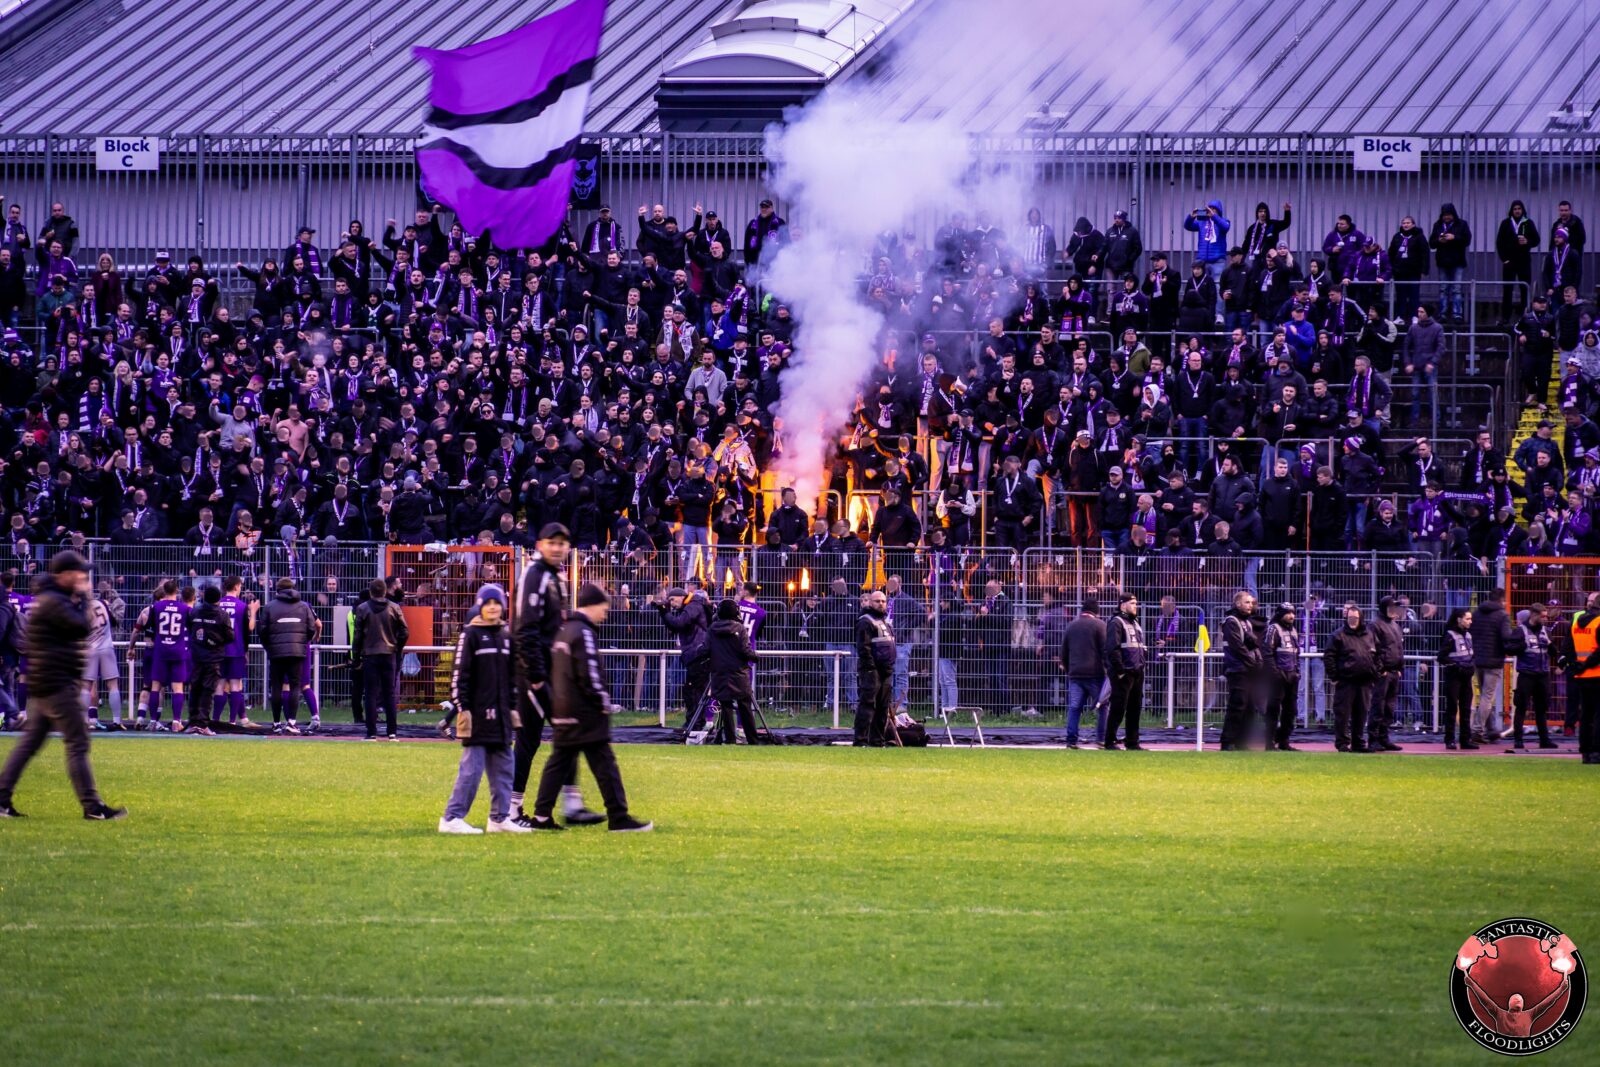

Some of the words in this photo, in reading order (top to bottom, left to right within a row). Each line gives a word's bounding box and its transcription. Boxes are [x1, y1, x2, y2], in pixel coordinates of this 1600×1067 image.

[105, 139, 150, 152] Block
[1363, 138, 1412, 152] Block
[121, 155, 134, 167] C
[1381, 155, 1394, 168] C
[158, 611, 182, 636] 26
